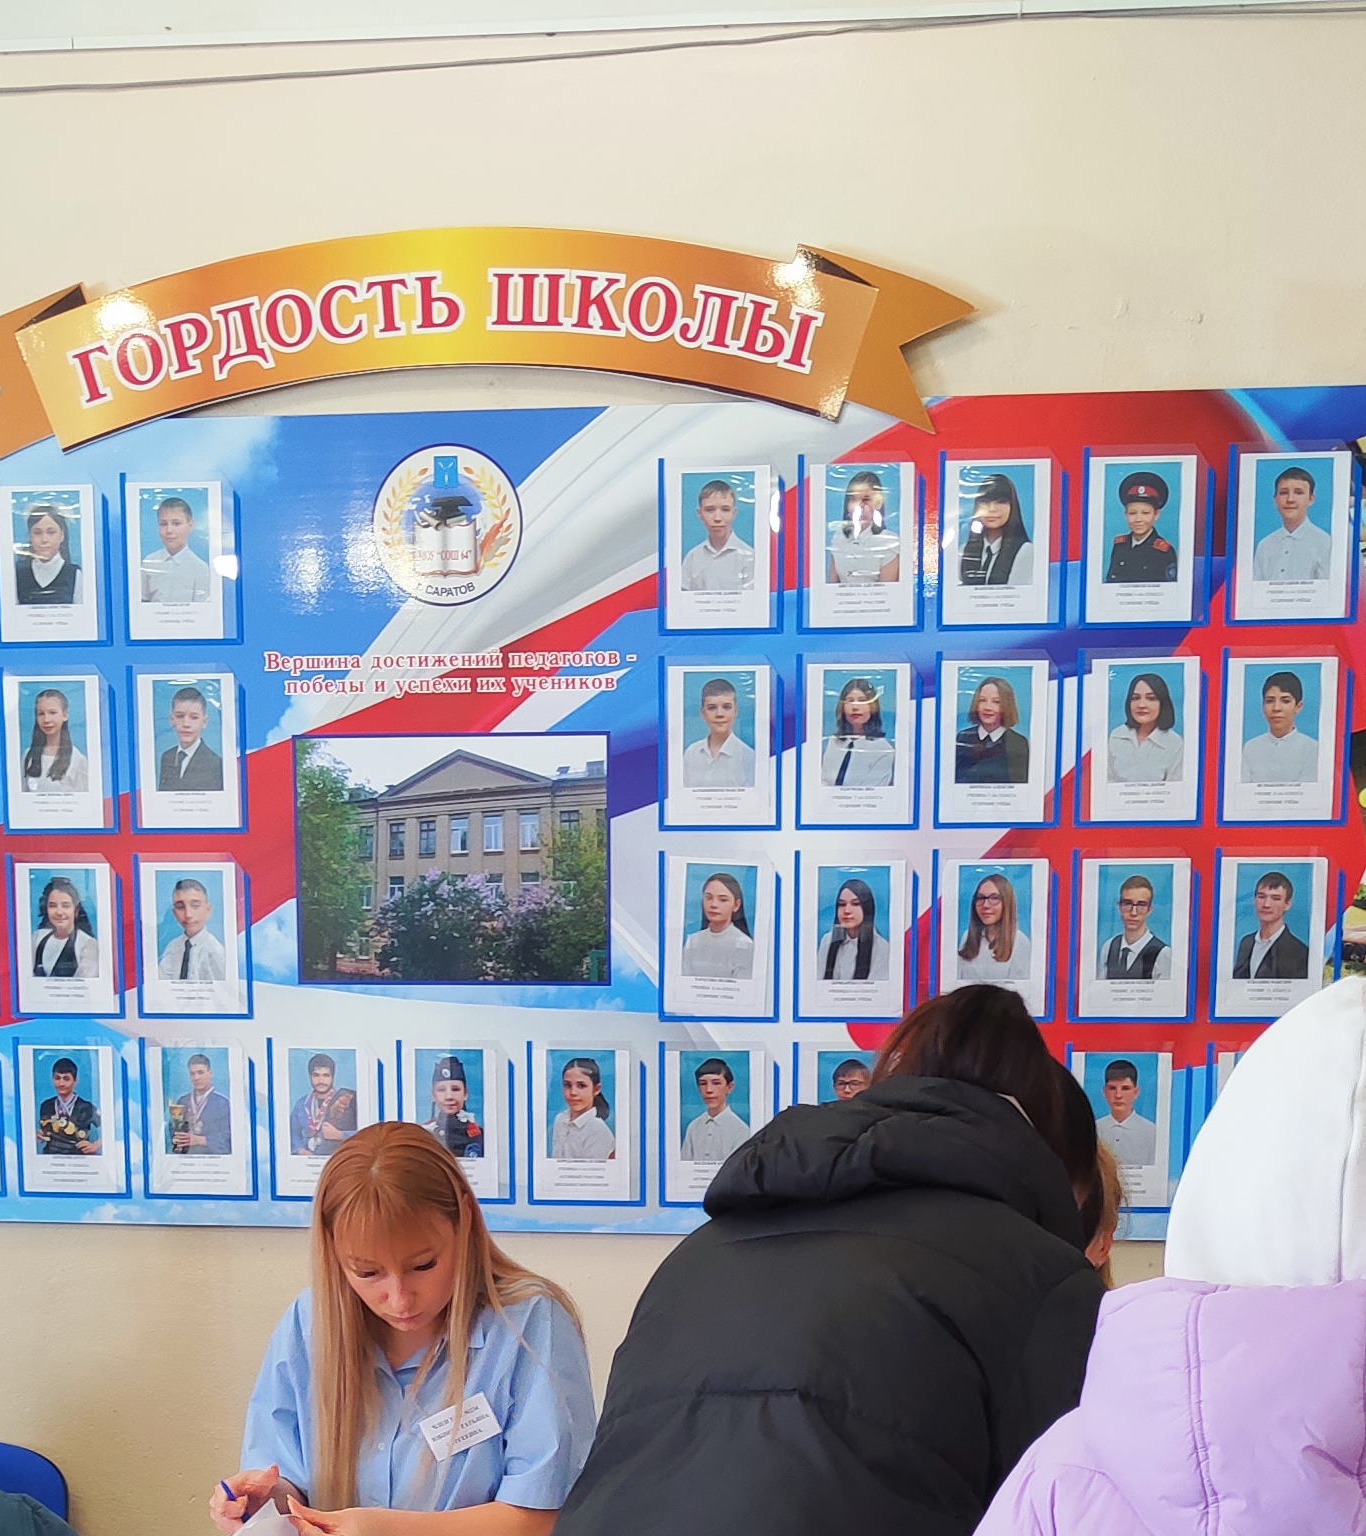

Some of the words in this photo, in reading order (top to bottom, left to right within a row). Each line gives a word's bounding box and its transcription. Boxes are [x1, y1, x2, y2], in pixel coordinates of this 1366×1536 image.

[73, 271, 463, 407] ГОРДОСТЬ
[490, 268, 821, 372] ШКОЛЫ
[425, 582, 476, 597] САРАТОВ
[265, 652, 362, 673] Вершина
[370, 649, 501, 671] достижений
[508, 651, 619, 669] педагогов
[285, 676, 365, 695] победы
[374, 678, 386, 693] и
[395, 678, 471, 696] успехи
[477, 677, 506, 693] их
[514, 676, 616, 696] учеников
